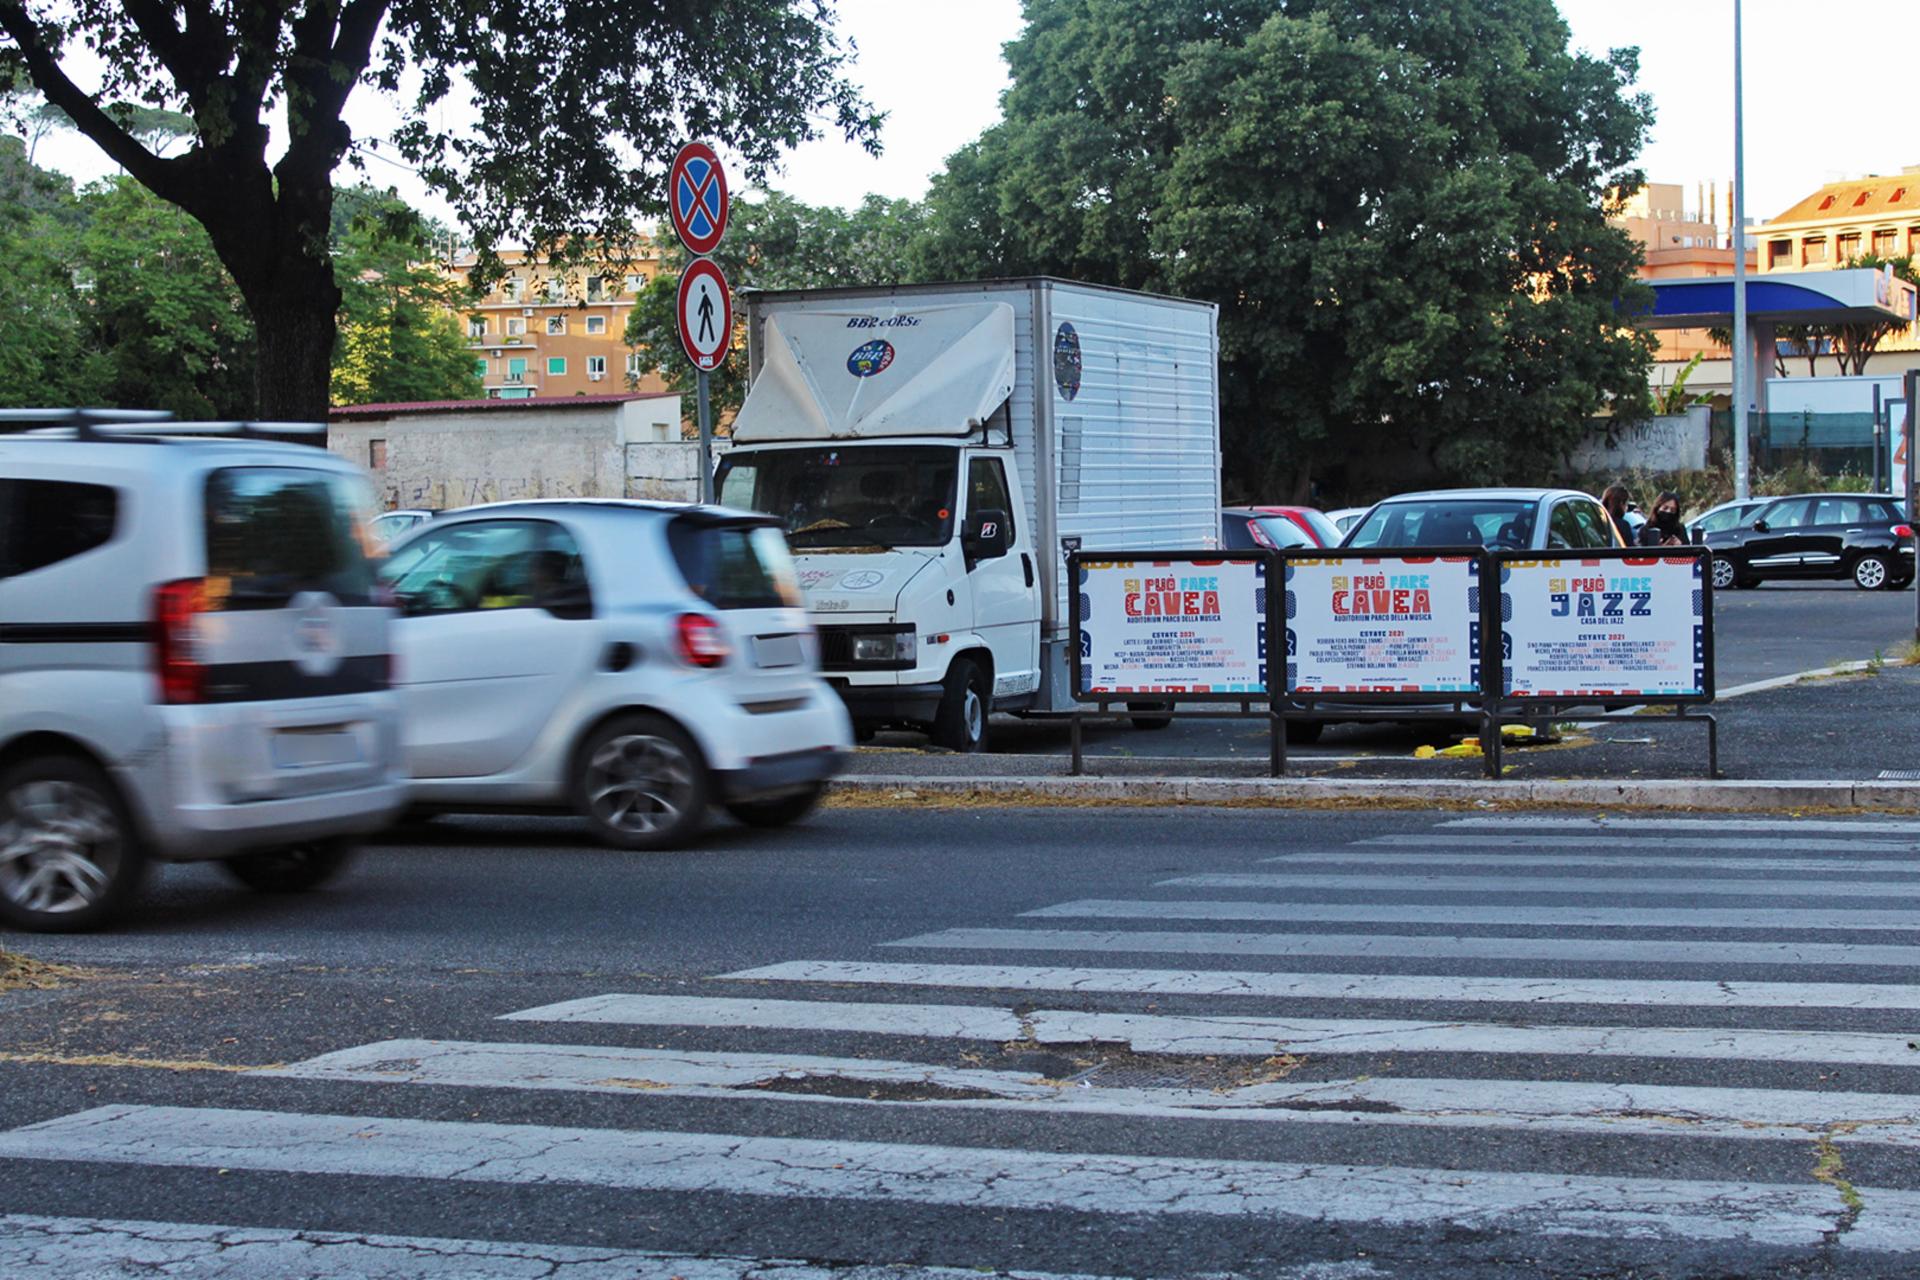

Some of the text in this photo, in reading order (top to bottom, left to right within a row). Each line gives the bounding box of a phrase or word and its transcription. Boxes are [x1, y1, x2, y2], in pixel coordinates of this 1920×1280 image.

[847, 317, 879, 328] BBR
[1124, 578, 1140, 592] SI
[1181, 577, 1218, 591] FARE
[1332, 576, 1349, 590] SI
[1390, 575, 1430, 589] FARE
[1549, 578, 1566, 592] SI
[1610, 577, 1652, 592] FARE
[1125, 591, 1220, 616] CAVEA
[1332, 589, 1431, 614] CAVEA
[1551, 592, 1652, 616] JAZZ
[1199, 614, 1221, 622] MUSICA
[1409, 613, 1432, 621] MUSICA
[1581, 617, 1597, 625] CASA
